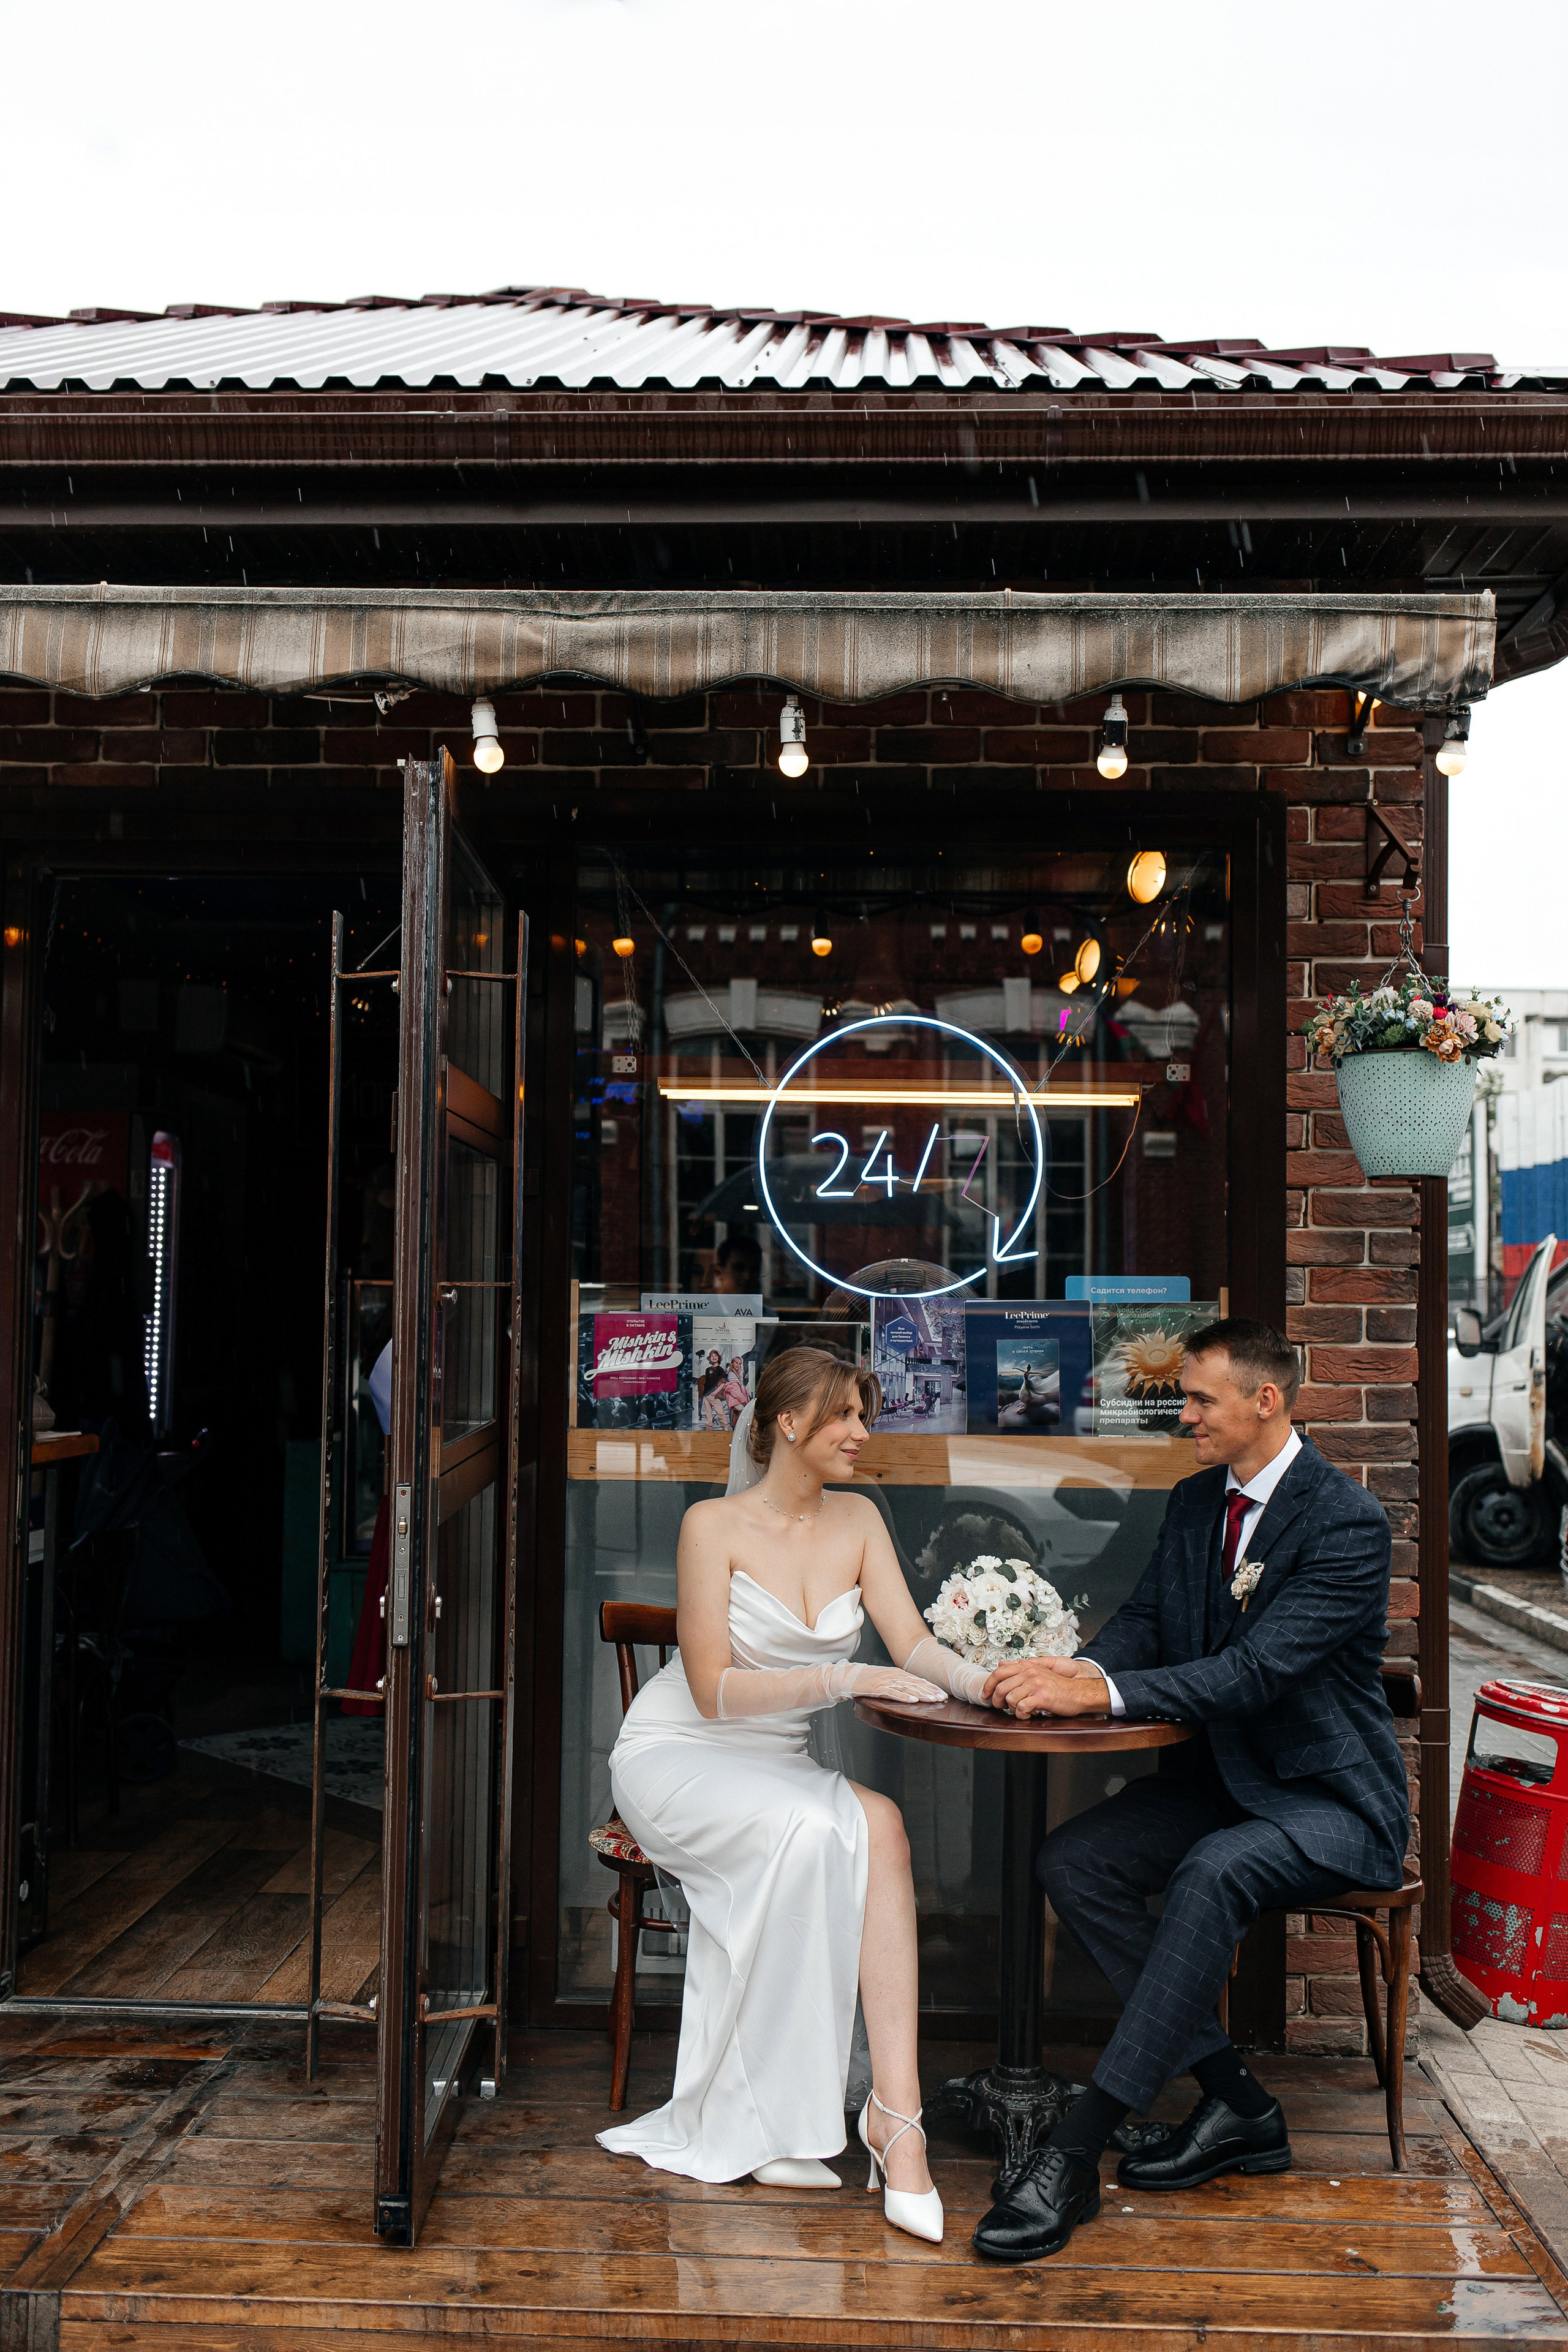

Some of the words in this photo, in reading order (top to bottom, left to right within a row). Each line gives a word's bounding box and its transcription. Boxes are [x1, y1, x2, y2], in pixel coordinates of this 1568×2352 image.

[811, 1123, 990, 1197] 24/7
[649, 1299, 709, 1310] LeePrime
[734, 1308, 753, 1317] AVA
[1005, 1311, 1050, 1320] LeePrime
[608, 1330, 666, 1352] Mishkin
[667, 1330, 677, 1344] &
[597, 1342, 673, 1371] Mishkin
[1100, 1398, 1142, 1408] Субсидии
